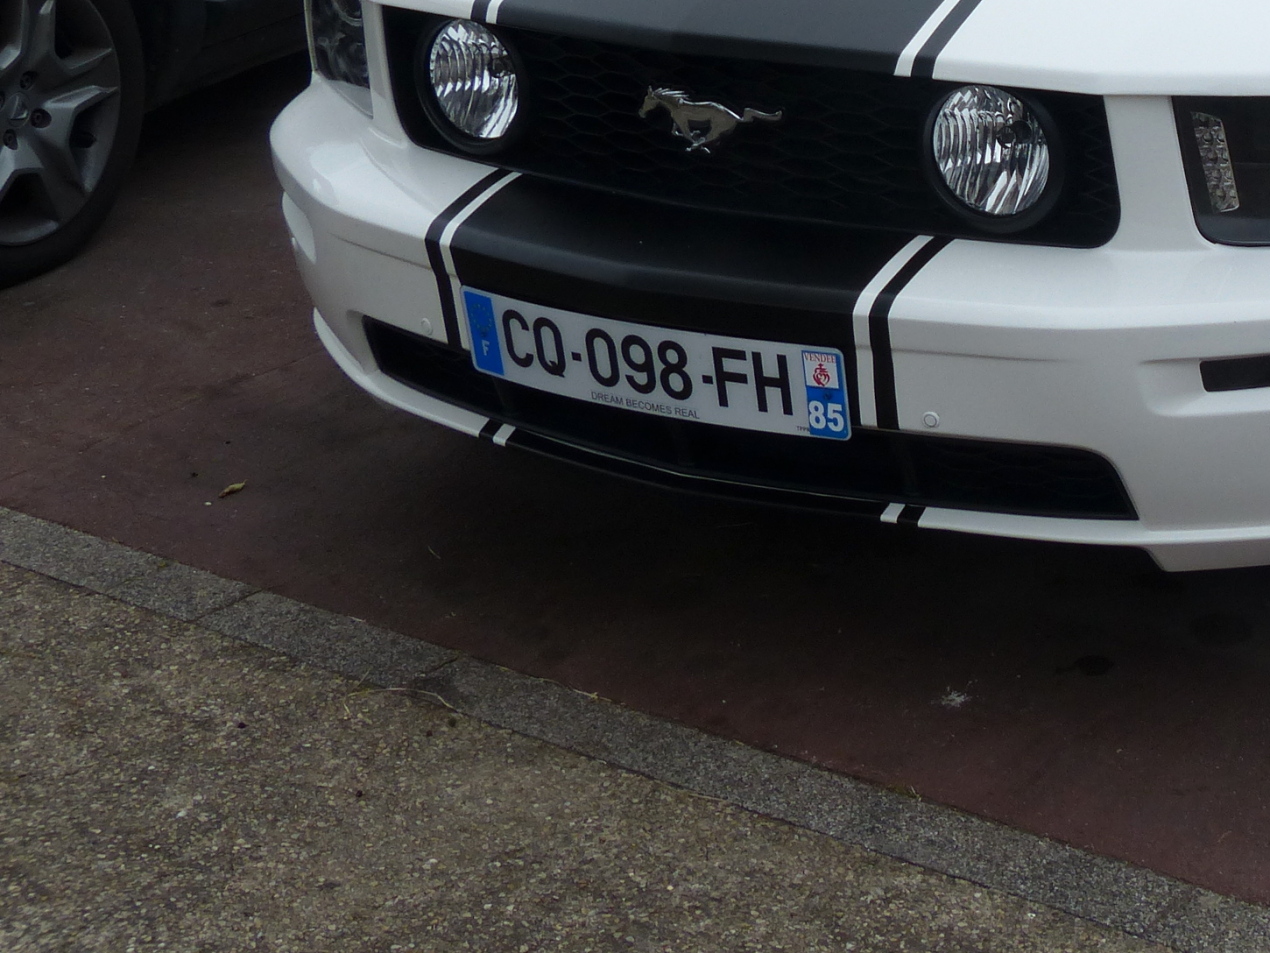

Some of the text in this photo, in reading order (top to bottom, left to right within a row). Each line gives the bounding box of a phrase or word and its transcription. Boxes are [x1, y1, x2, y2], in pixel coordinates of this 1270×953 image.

[480, 339, 491, 357] F
[502, 308, 794, 416] CQ-098-FH
[590, 390, 700, 420] DREAM BECOMES REAL
[808, 400, 845, 432] 85
